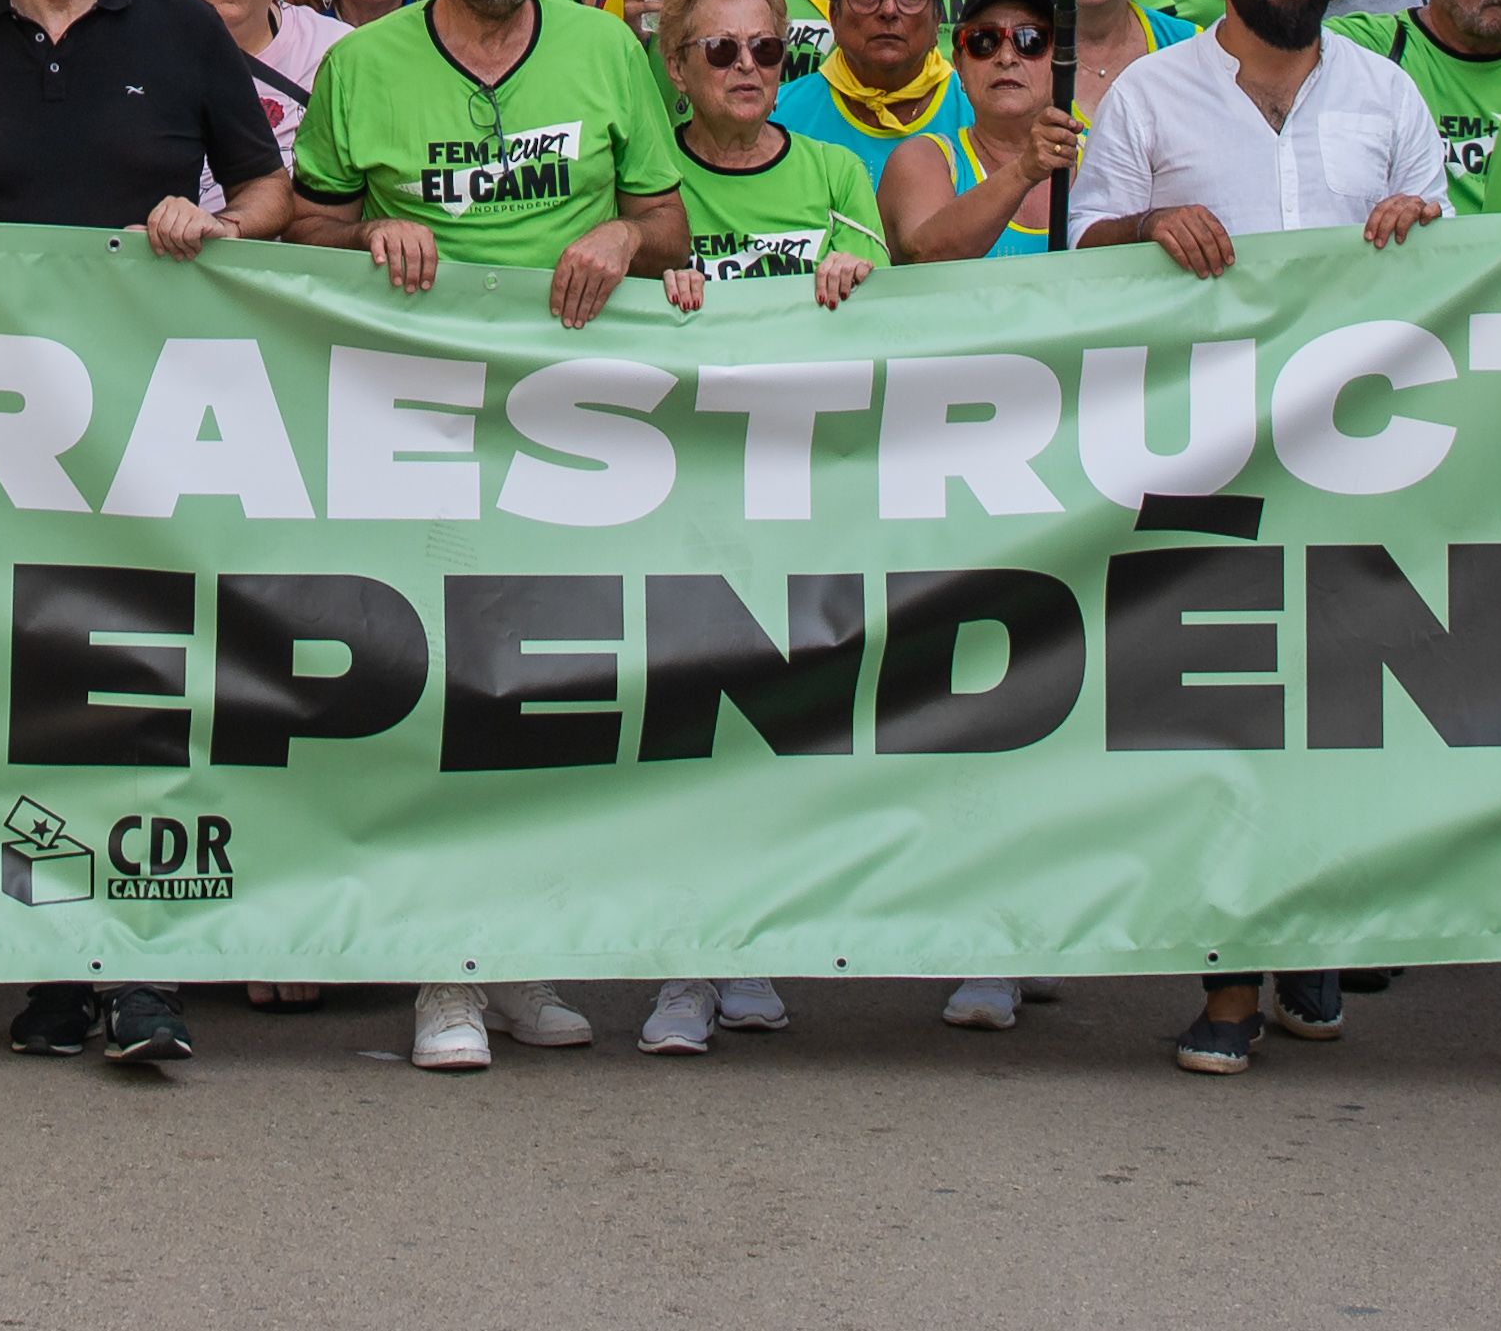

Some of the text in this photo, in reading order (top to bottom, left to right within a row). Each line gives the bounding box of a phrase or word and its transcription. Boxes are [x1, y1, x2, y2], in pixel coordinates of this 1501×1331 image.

[428, 141, 490, 164] FEM
[421, 158, 571, 204] EL CAMÍ
[107, 814, 234, 877] CDR
[110, 878, 232, 899] CATALUNYA
